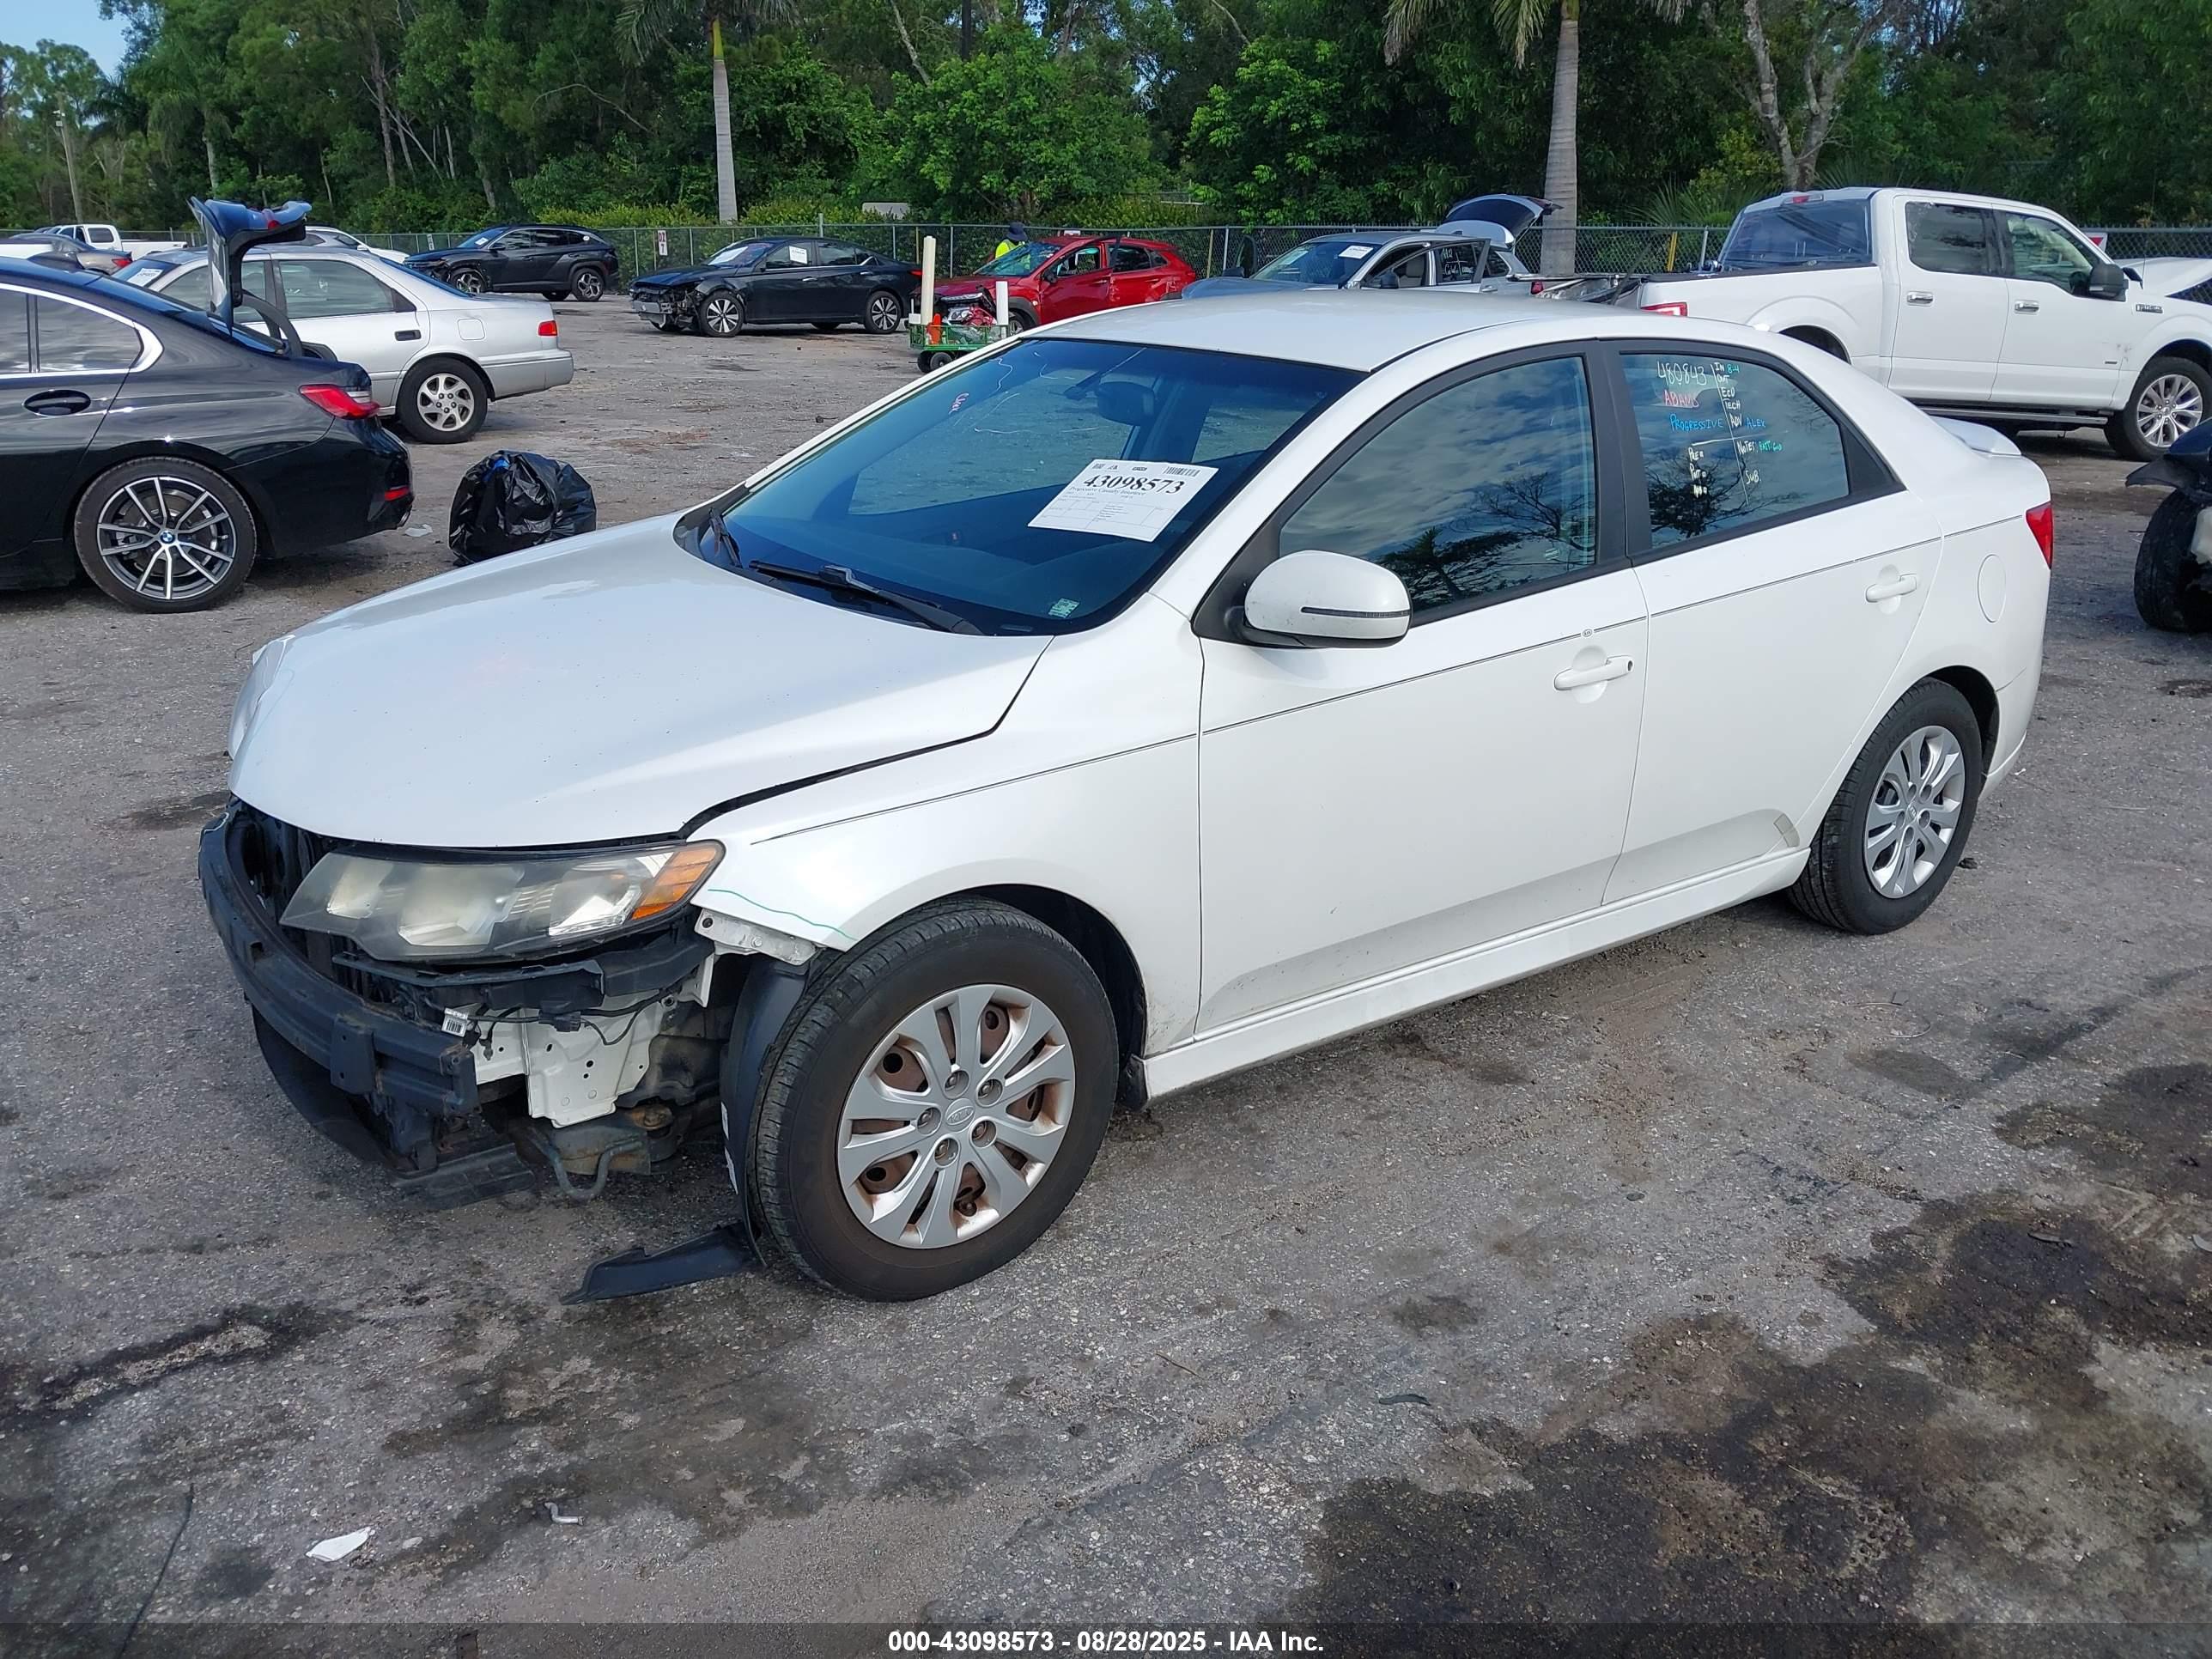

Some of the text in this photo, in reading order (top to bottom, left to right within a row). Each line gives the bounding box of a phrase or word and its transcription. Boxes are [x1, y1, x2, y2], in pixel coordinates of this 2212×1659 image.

[1656, 361, 1707, 386] 480843
[1714, 362, 1725, 372] IN
[1669, 413, 1723, 432] PROGRESSIVE
[1084, 474, 1185, 494] 43098573
